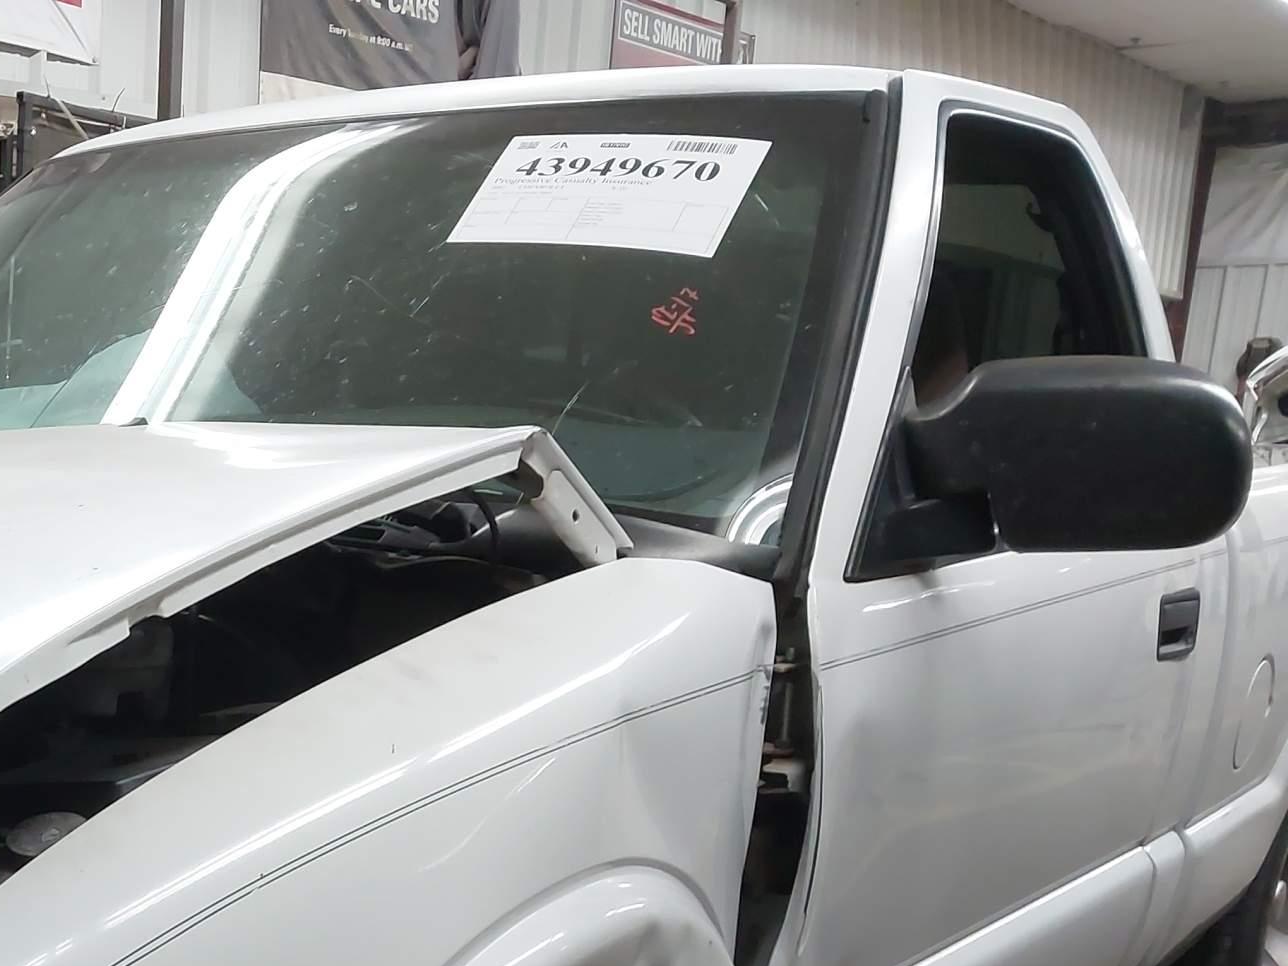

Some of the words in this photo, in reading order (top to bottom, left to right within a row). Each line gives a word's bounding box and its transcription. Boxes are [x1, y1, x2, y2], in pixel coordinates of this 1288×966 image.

[328, 23, 347, 38] Every
[623, 8, 650, 41] SELL
[653, 18, 695, 54] SMART
[515, 155, 721, 182] 43949670
